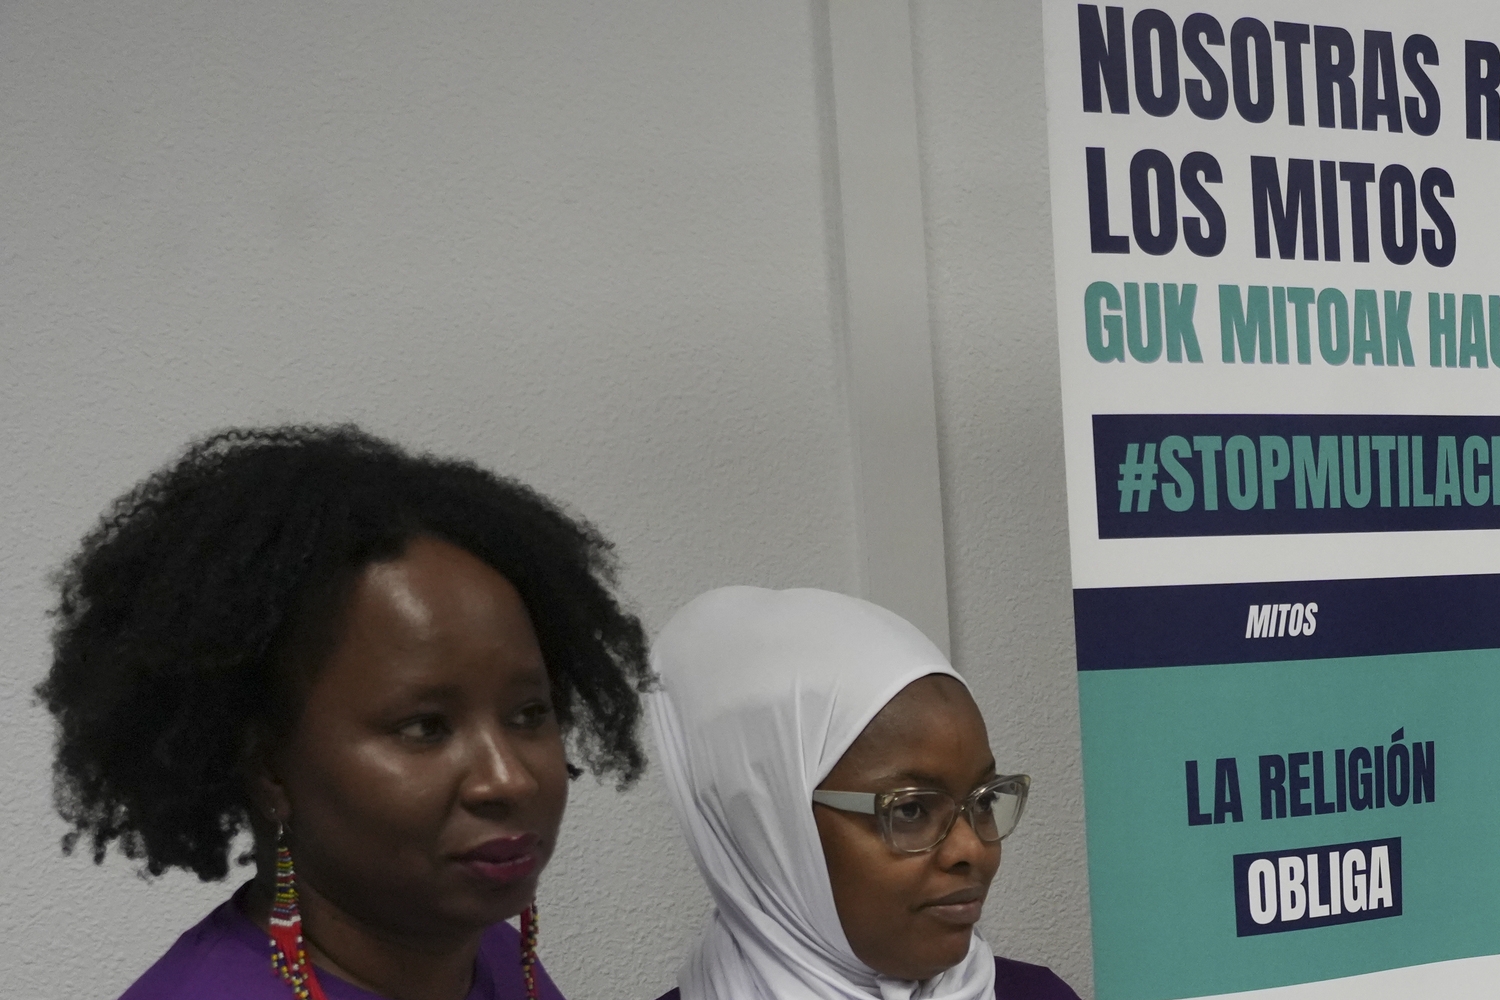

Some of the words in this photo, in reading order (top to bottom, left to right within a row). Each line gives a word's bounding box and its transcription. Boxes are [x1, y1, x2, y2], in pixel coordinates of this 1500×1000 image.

[1078, 4, 1441, 136] NOSOTRAS
[1085, 147, 1227, 257] LOS
[1250, 156, 1456, 267] MITOS
[1084, 281, 1204, 364] GUK
[1219, 284, 1415, 367] MITOAK
[1245, 602, 1318, 638] MITOS
[1185, 757, 1243, 826] LA
[1259, 727, 1435, 820] RELIGIÓN
[1248, 845, 1392, 925] OBLIGA
